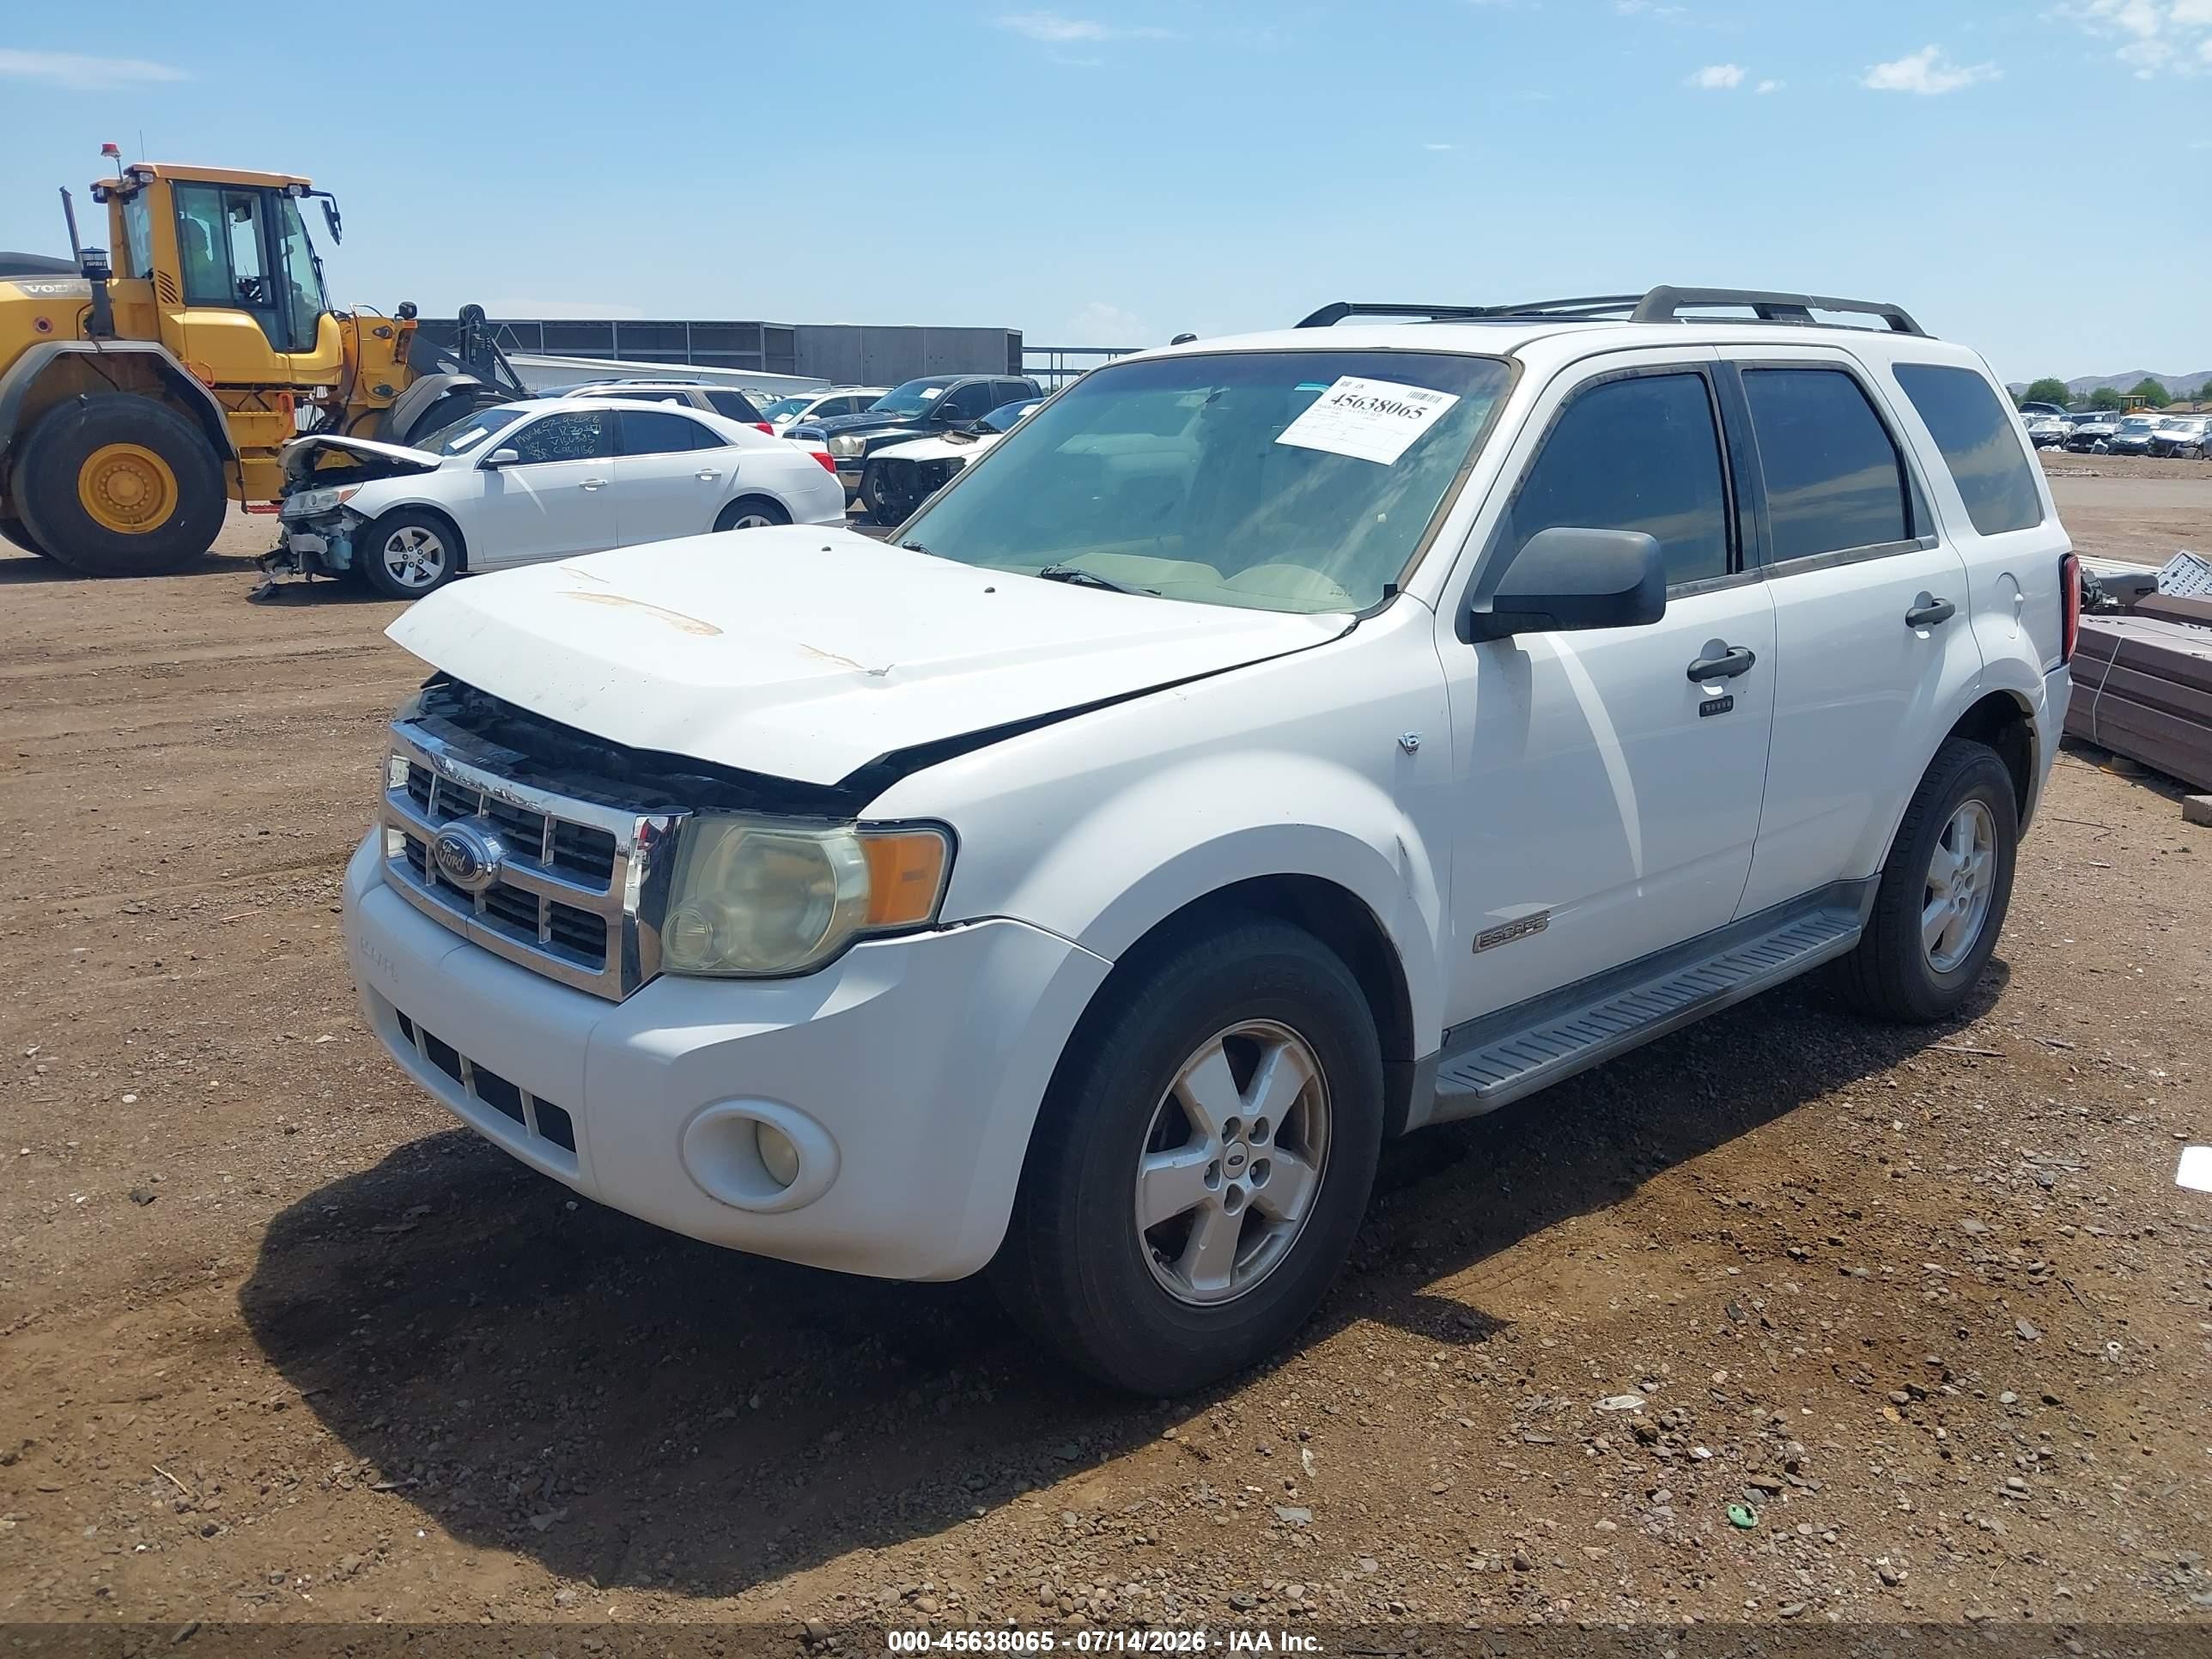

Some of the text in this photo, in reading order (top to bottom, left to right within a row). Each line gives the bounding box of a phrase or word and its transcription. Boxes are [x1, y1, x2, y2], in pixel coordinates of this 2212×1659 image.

[1330, 392, 1429, 420] 45638065
[439, 839, 466, 872] Ford
[1479, 915, 1546, 948] ESCAPE
